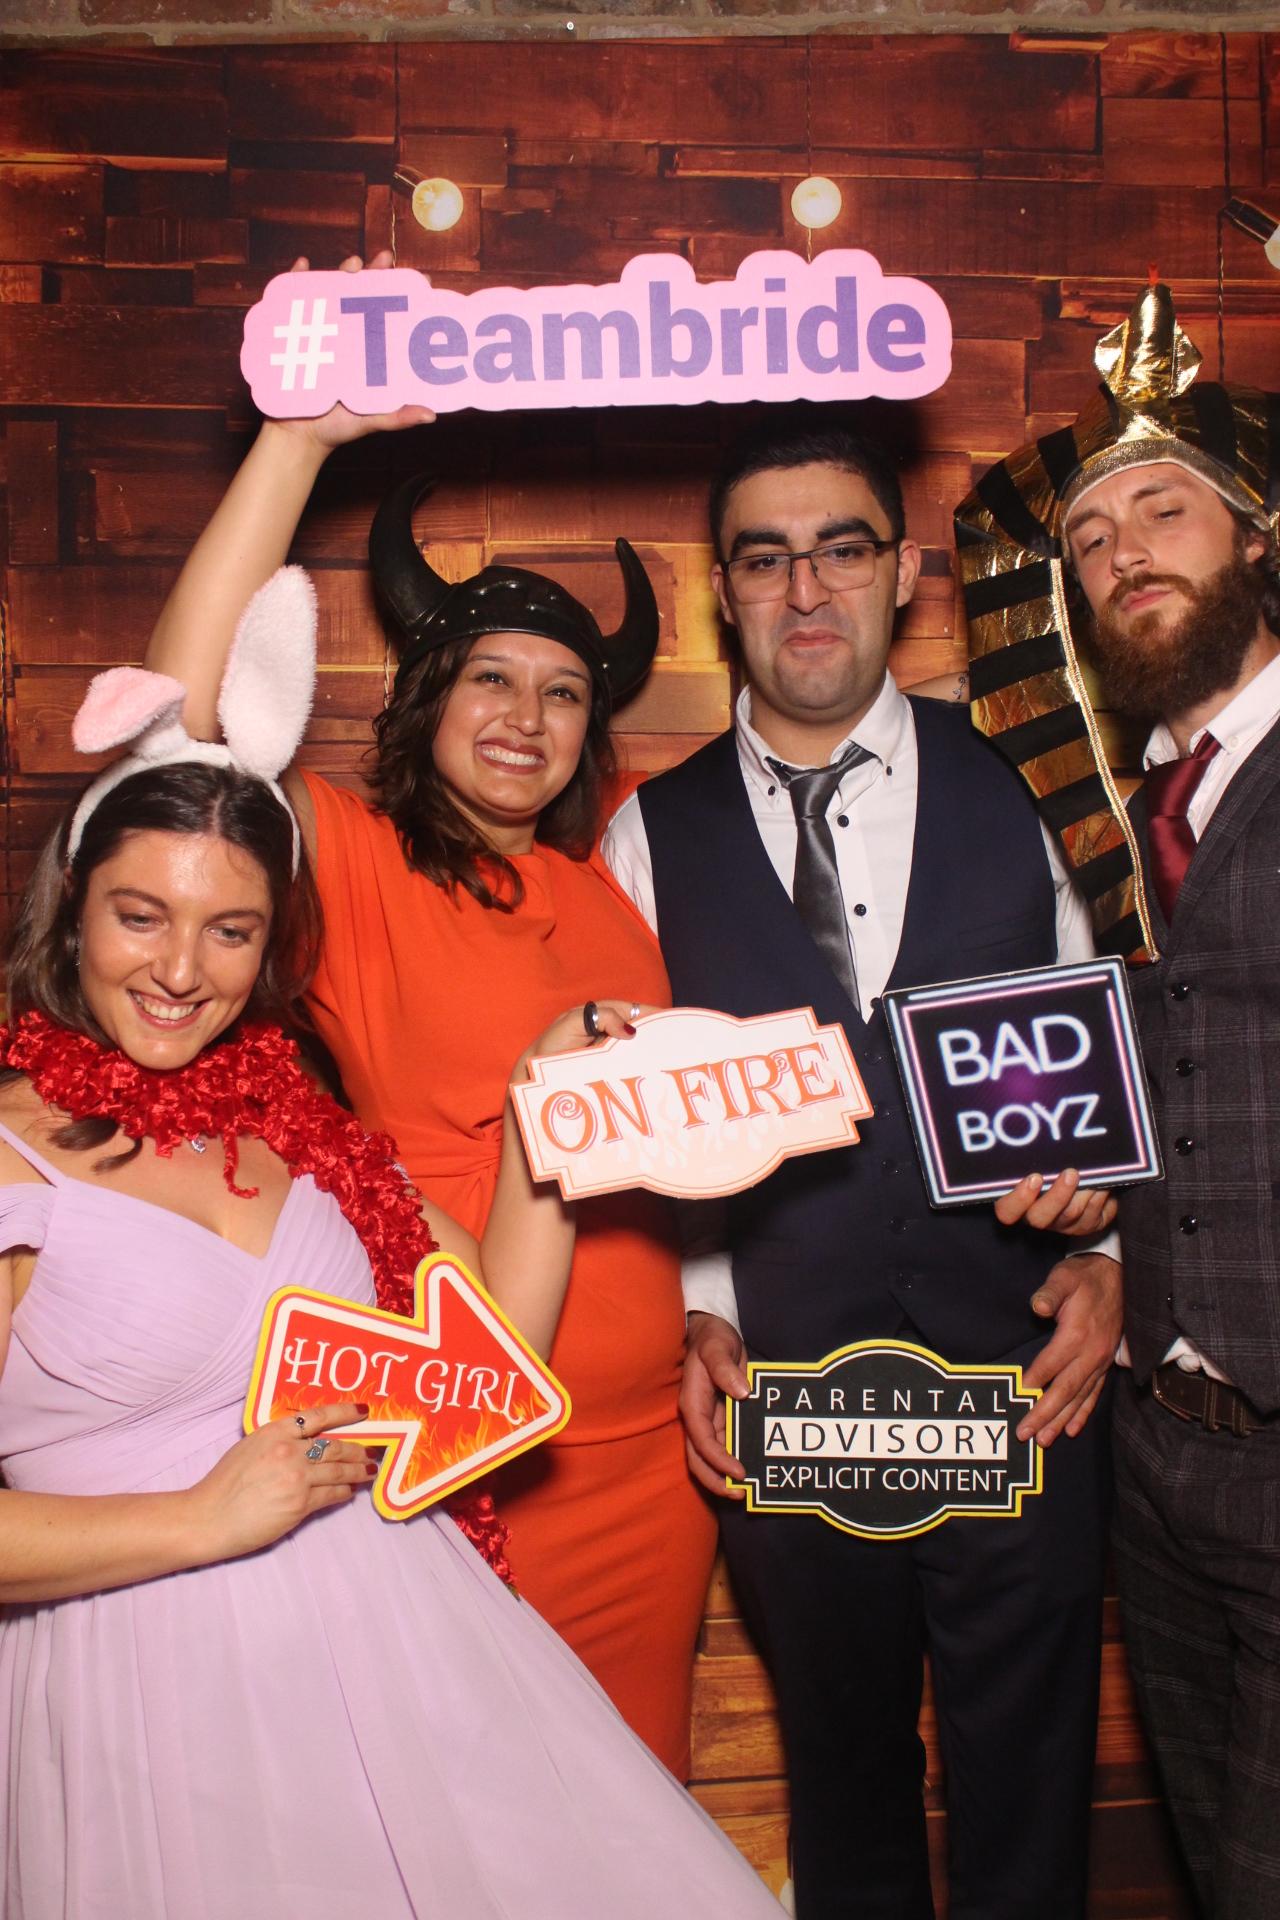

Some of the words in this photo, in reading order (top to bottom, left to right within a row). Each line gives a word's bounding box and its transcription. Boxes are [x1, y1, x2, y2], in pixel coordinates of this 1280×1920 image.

[269, 276, 927, 391] #Teambride
[938, 1014, 1092, 1086] BAD
[540, 1075, 654, 1154] ON
[661, 1042, 845, 1130] FIRE
[957, 1094, 1107, 1152] BOYZ
[284, 1337, 409, 1397] HOT
[415, 1359, 527, 1426] GIRL
[765, 1387, 1007, 1413] PARENTAL
[766, 1422, 1007, 1455] ADVISORY
[765, 1465, 876, 1489] EXPLICIT
[882, 1468, 1007, 1491] CONTENT
